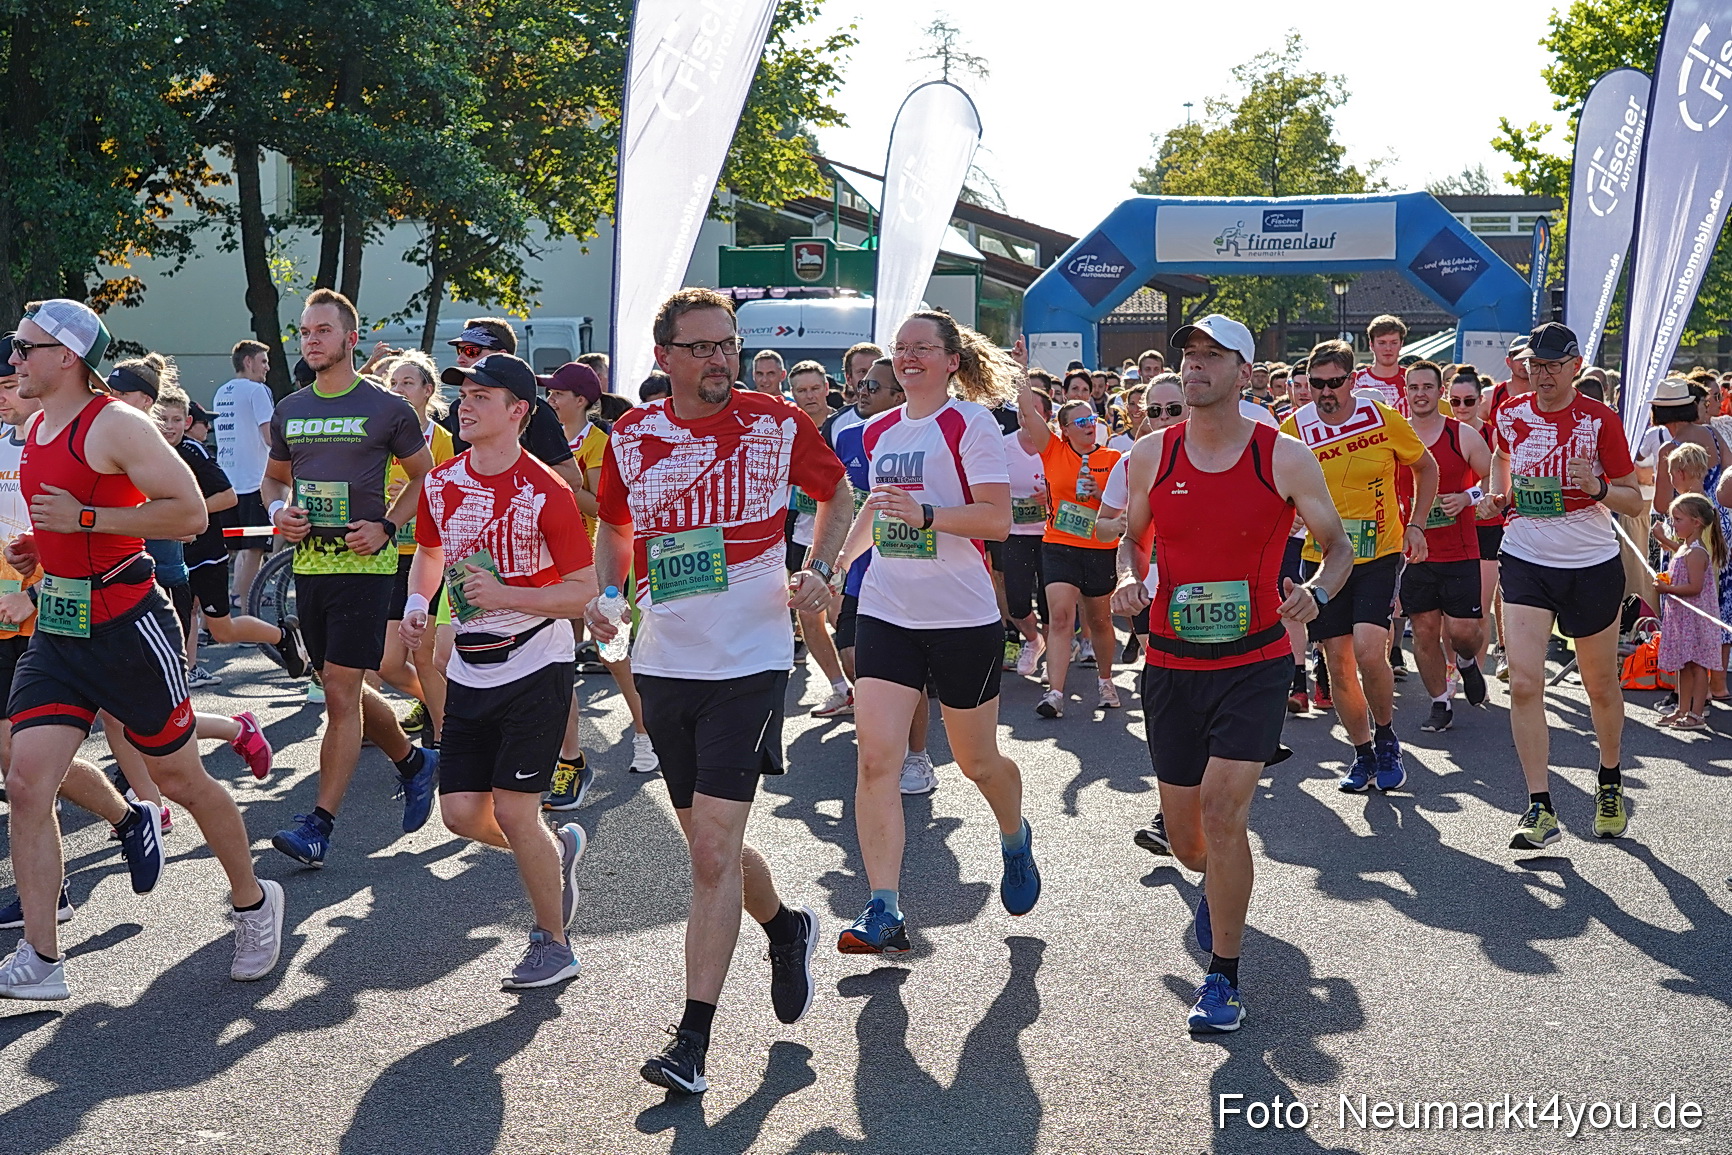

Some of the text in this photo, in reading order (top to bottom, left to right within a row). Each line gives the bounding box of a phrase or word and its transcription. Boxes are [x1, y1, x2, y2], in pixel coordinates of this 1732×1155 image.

[1599, 94, 1641, 197] Fischer
[1271, 217, 1301, 225] Fischer
[1249, 232, 1337, 250] firmenlauf
[1077, 263, 1124, 273] Fischer
[287, 418, 364, 434] BOCK
[625, 424, 656, 432] 9.0276
[1315, 432, 1388, 462] AX BÖGL
[875, 451, 925, 477] OM
[662, 474, 688, 483] 26.22
[306, 497, 333, 512] 633
[1518, 489, 1553, 505] 1105
[1554, 493, 1562, 511] 2022
[1018, 506, 1037, 516] 932
[1061, 511, 1090, 528] 1396
[887, 523, 919, 541] 506
[1086, 521, 1094, 535] 2022
[657, 550, 711, 580] 1098
[713, 552, 723, 583] 2022
[651, 568, 659, 591] RUN
[689, 574, 715, 584] Stefan
[79, 603, 87, 630] 2022
[1173, 611, 1181, 631] RUN
[1182, 602, 1237, 623] 1158
[1239, 604, 1247, 631] 2022
[58, 618, 72, 626] Tim
